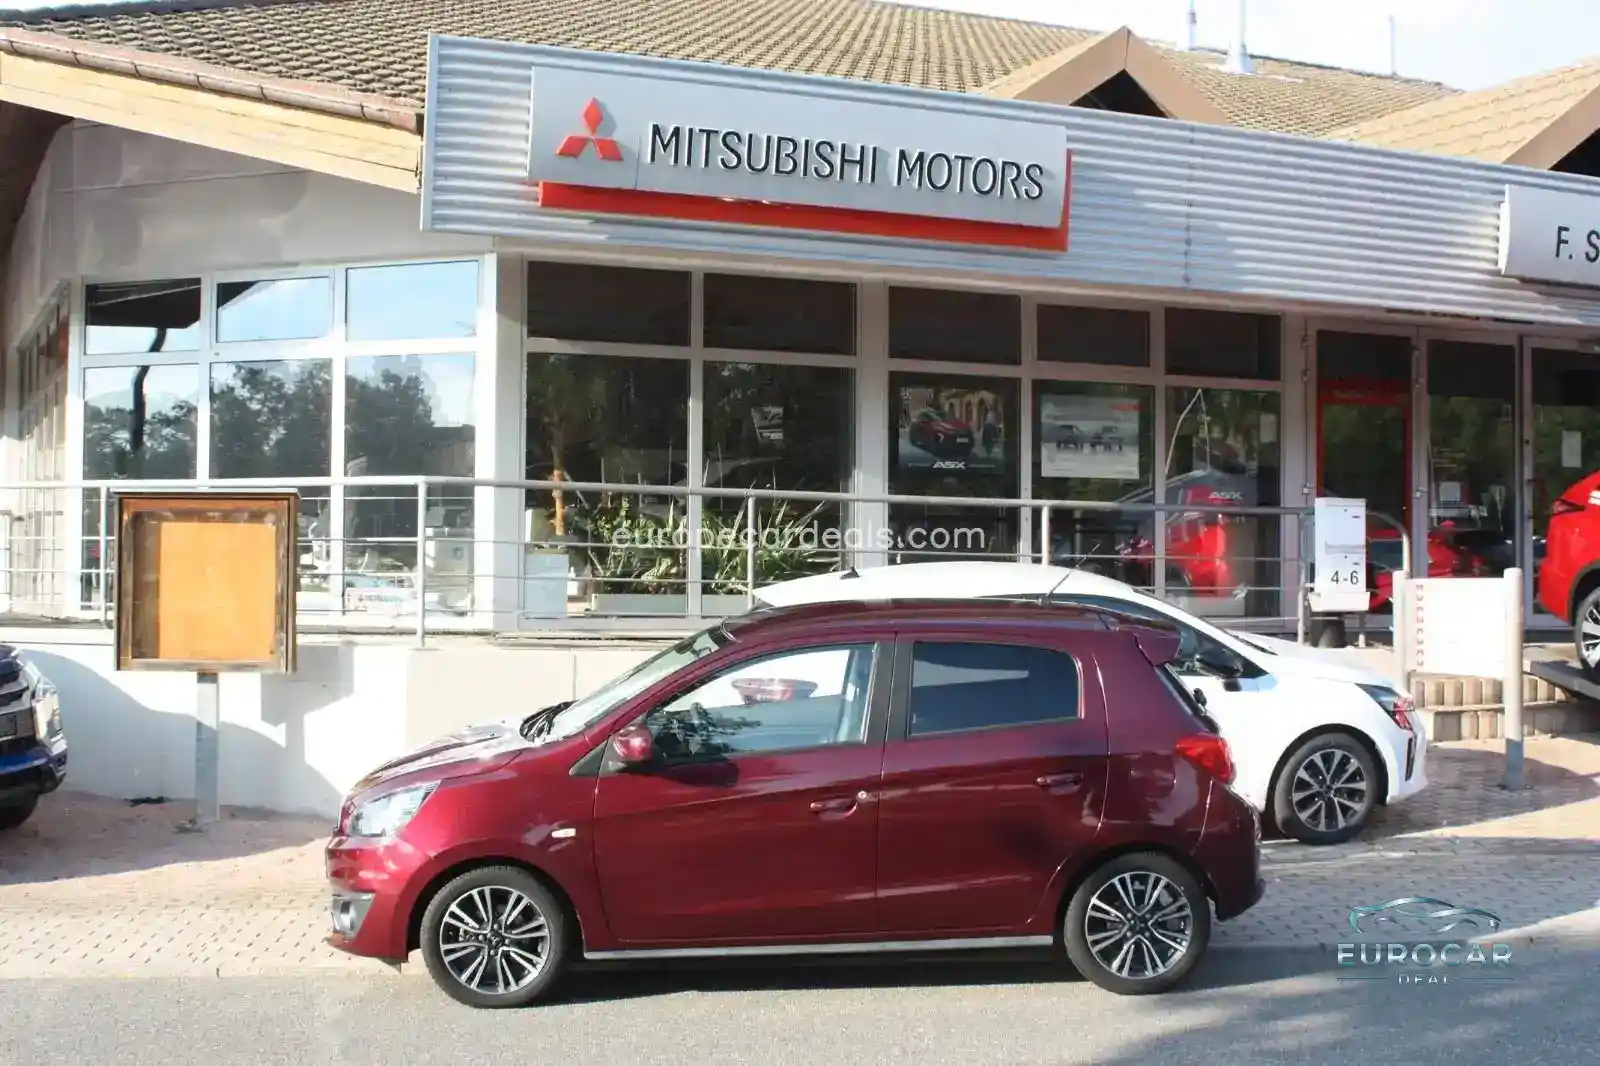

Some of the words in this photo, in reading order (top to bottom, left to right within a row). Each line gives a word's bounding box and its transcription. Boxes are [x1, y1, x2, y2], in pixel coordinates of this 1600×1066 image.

[647, 120, 878, 184] MITSUBISHI
[896, 147, 1044, 201] MOTORS
[1555, 225, 1573, 260] F.
[932, 461, 966, 469] ASX
[1331, 570, 1359, 585] 4-6
